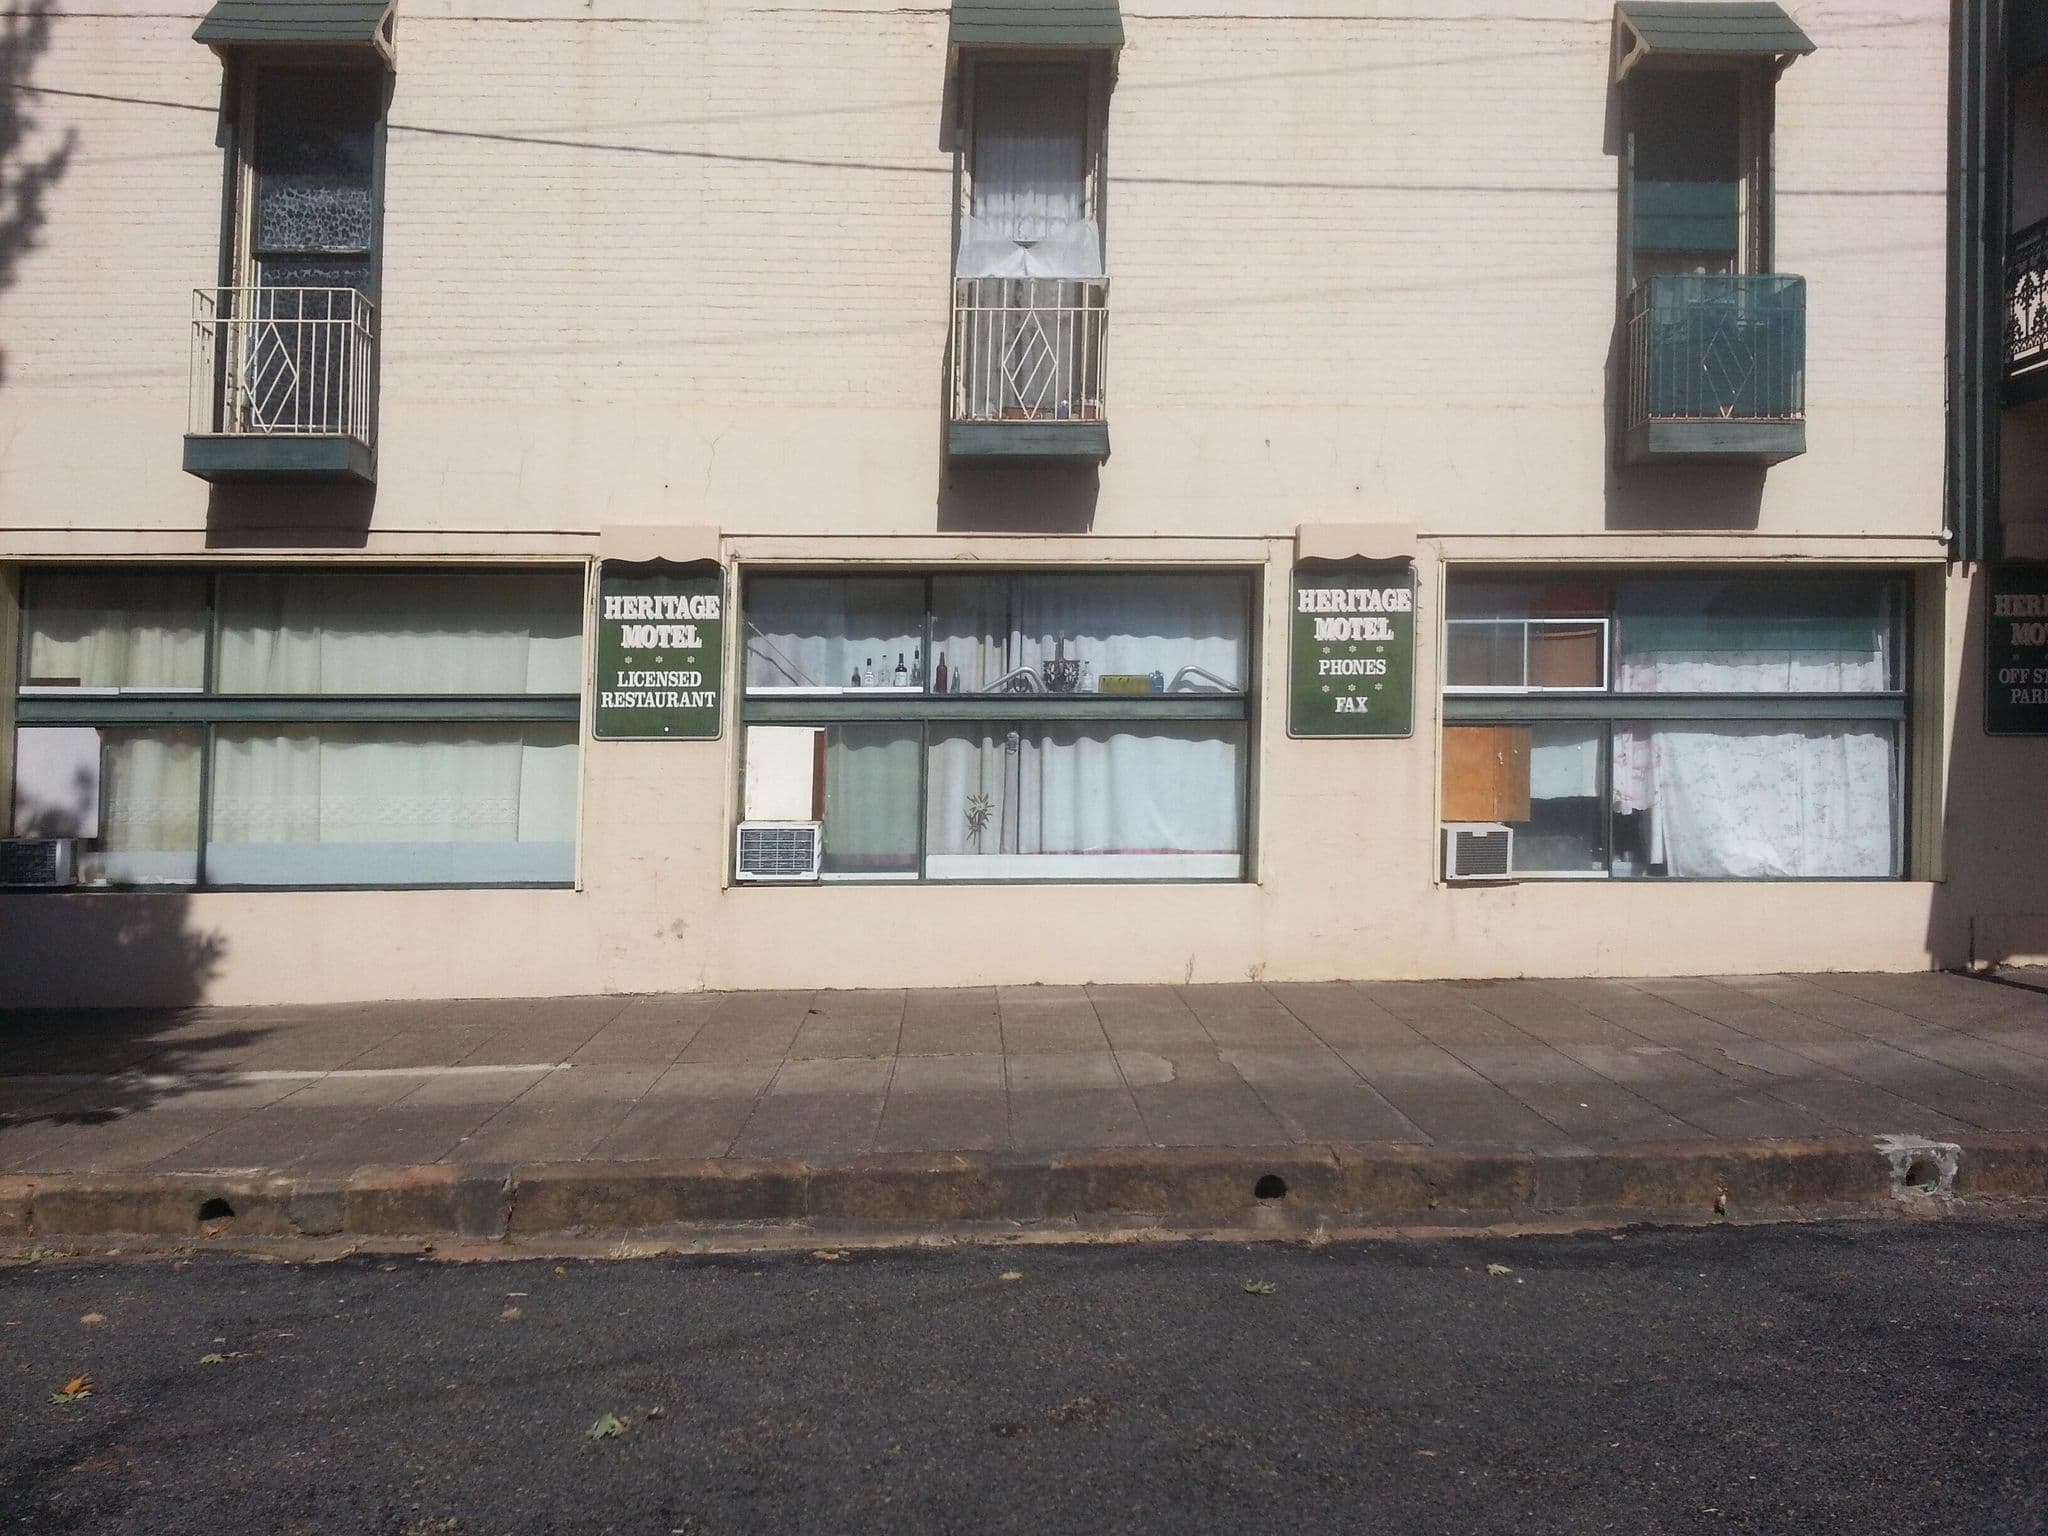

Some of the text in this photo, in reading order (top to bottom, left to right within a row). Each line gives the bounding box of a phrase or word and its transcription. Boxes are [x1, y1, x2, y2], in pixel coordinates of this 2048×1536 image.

[603, 595, 721, 620] HERITAGE
[1297, 588, 1412, 613] HERITAGE
[620, 624, 703, 649] MOTEL
[1313, 617, 1395, 641] MOTEL
[1318, 659, 1387, 676] PHONES
[1998, 668, 2030, 684] OFF
[616, 671, 702, 688] LICENSED
[600, 691, 716, 708] RESTAURANT
[1334, 696, 1369, 713] FAX
